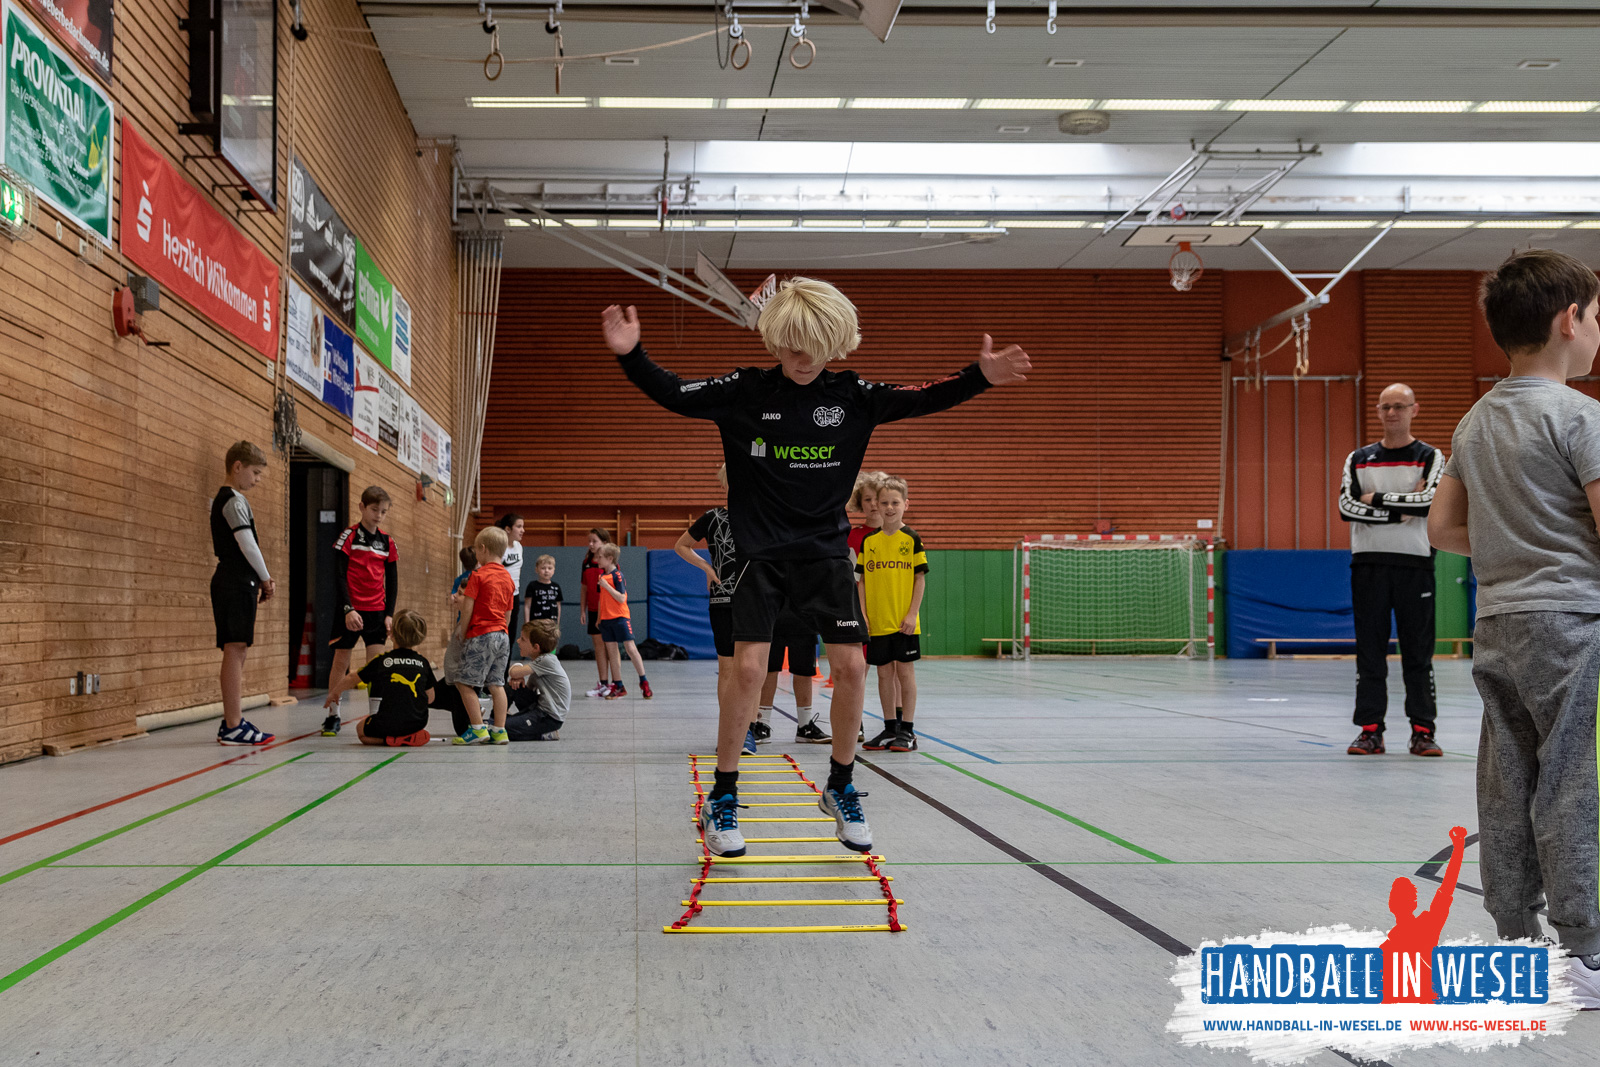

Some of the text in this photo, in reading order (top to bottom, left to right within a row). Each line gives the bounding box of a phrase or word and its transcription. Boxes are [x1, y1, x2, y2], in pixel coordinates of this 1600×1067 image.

[11, 32, 85, 133] PROVINZIAL
[163, 218, 205, 287] Herzlich
[206, 255, 258, 324] Willkommen
[358, 269, 380, 323] erima
[773, 445, 836, 460] wesser
[506, 553, 520, 561] NIKE
[876, 561, 912, 570] EVONIK
[394, 658, 424, 668] EVONIK
